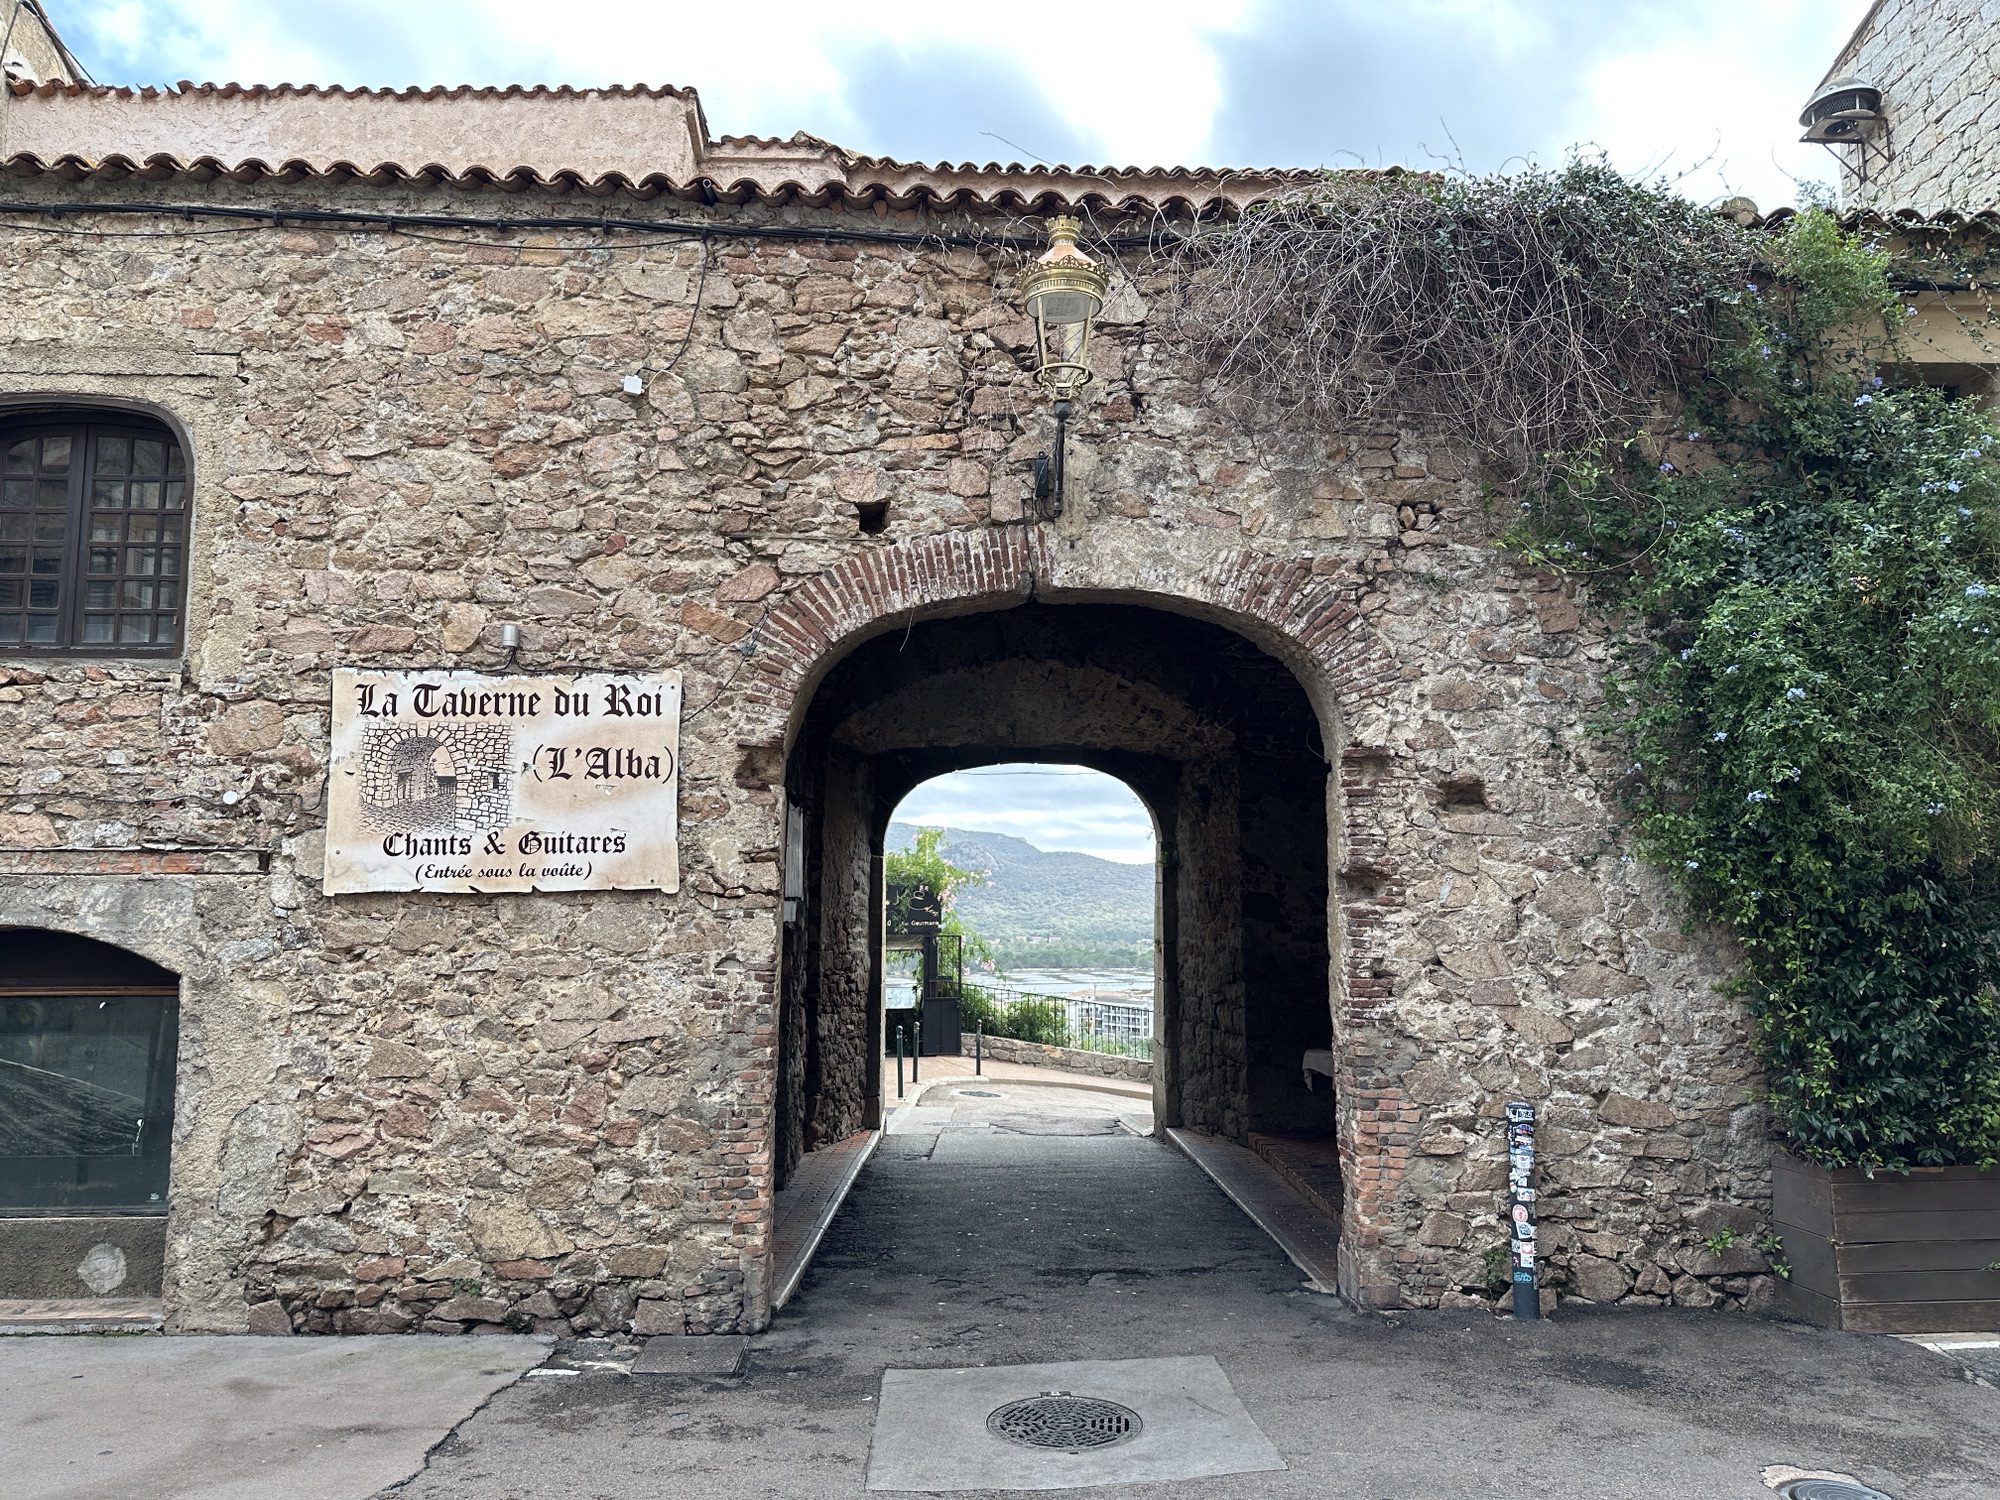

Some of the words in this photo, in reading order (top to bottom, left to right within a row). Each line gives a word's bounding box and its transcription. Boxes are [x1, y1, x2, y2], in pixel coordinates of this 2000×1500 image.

[354, 683, 399, 718] La
[412, 683, 542, 718] Taverne
[554, 685, 590, 717] du
[602, 683, 663, 718] Roi
[533, 744, 674, 784] (L'Alba)
[382, 831, 472, 860] Chants
[483, 830, 506, 856] &
[518, 830, 627, 856] Guitares
[415, 863, 473, 883] (Entrée
[478, 867, 513, 878] sous
[519, 862, 537, 877] la
[541, 861, 593, 881] voûte)
